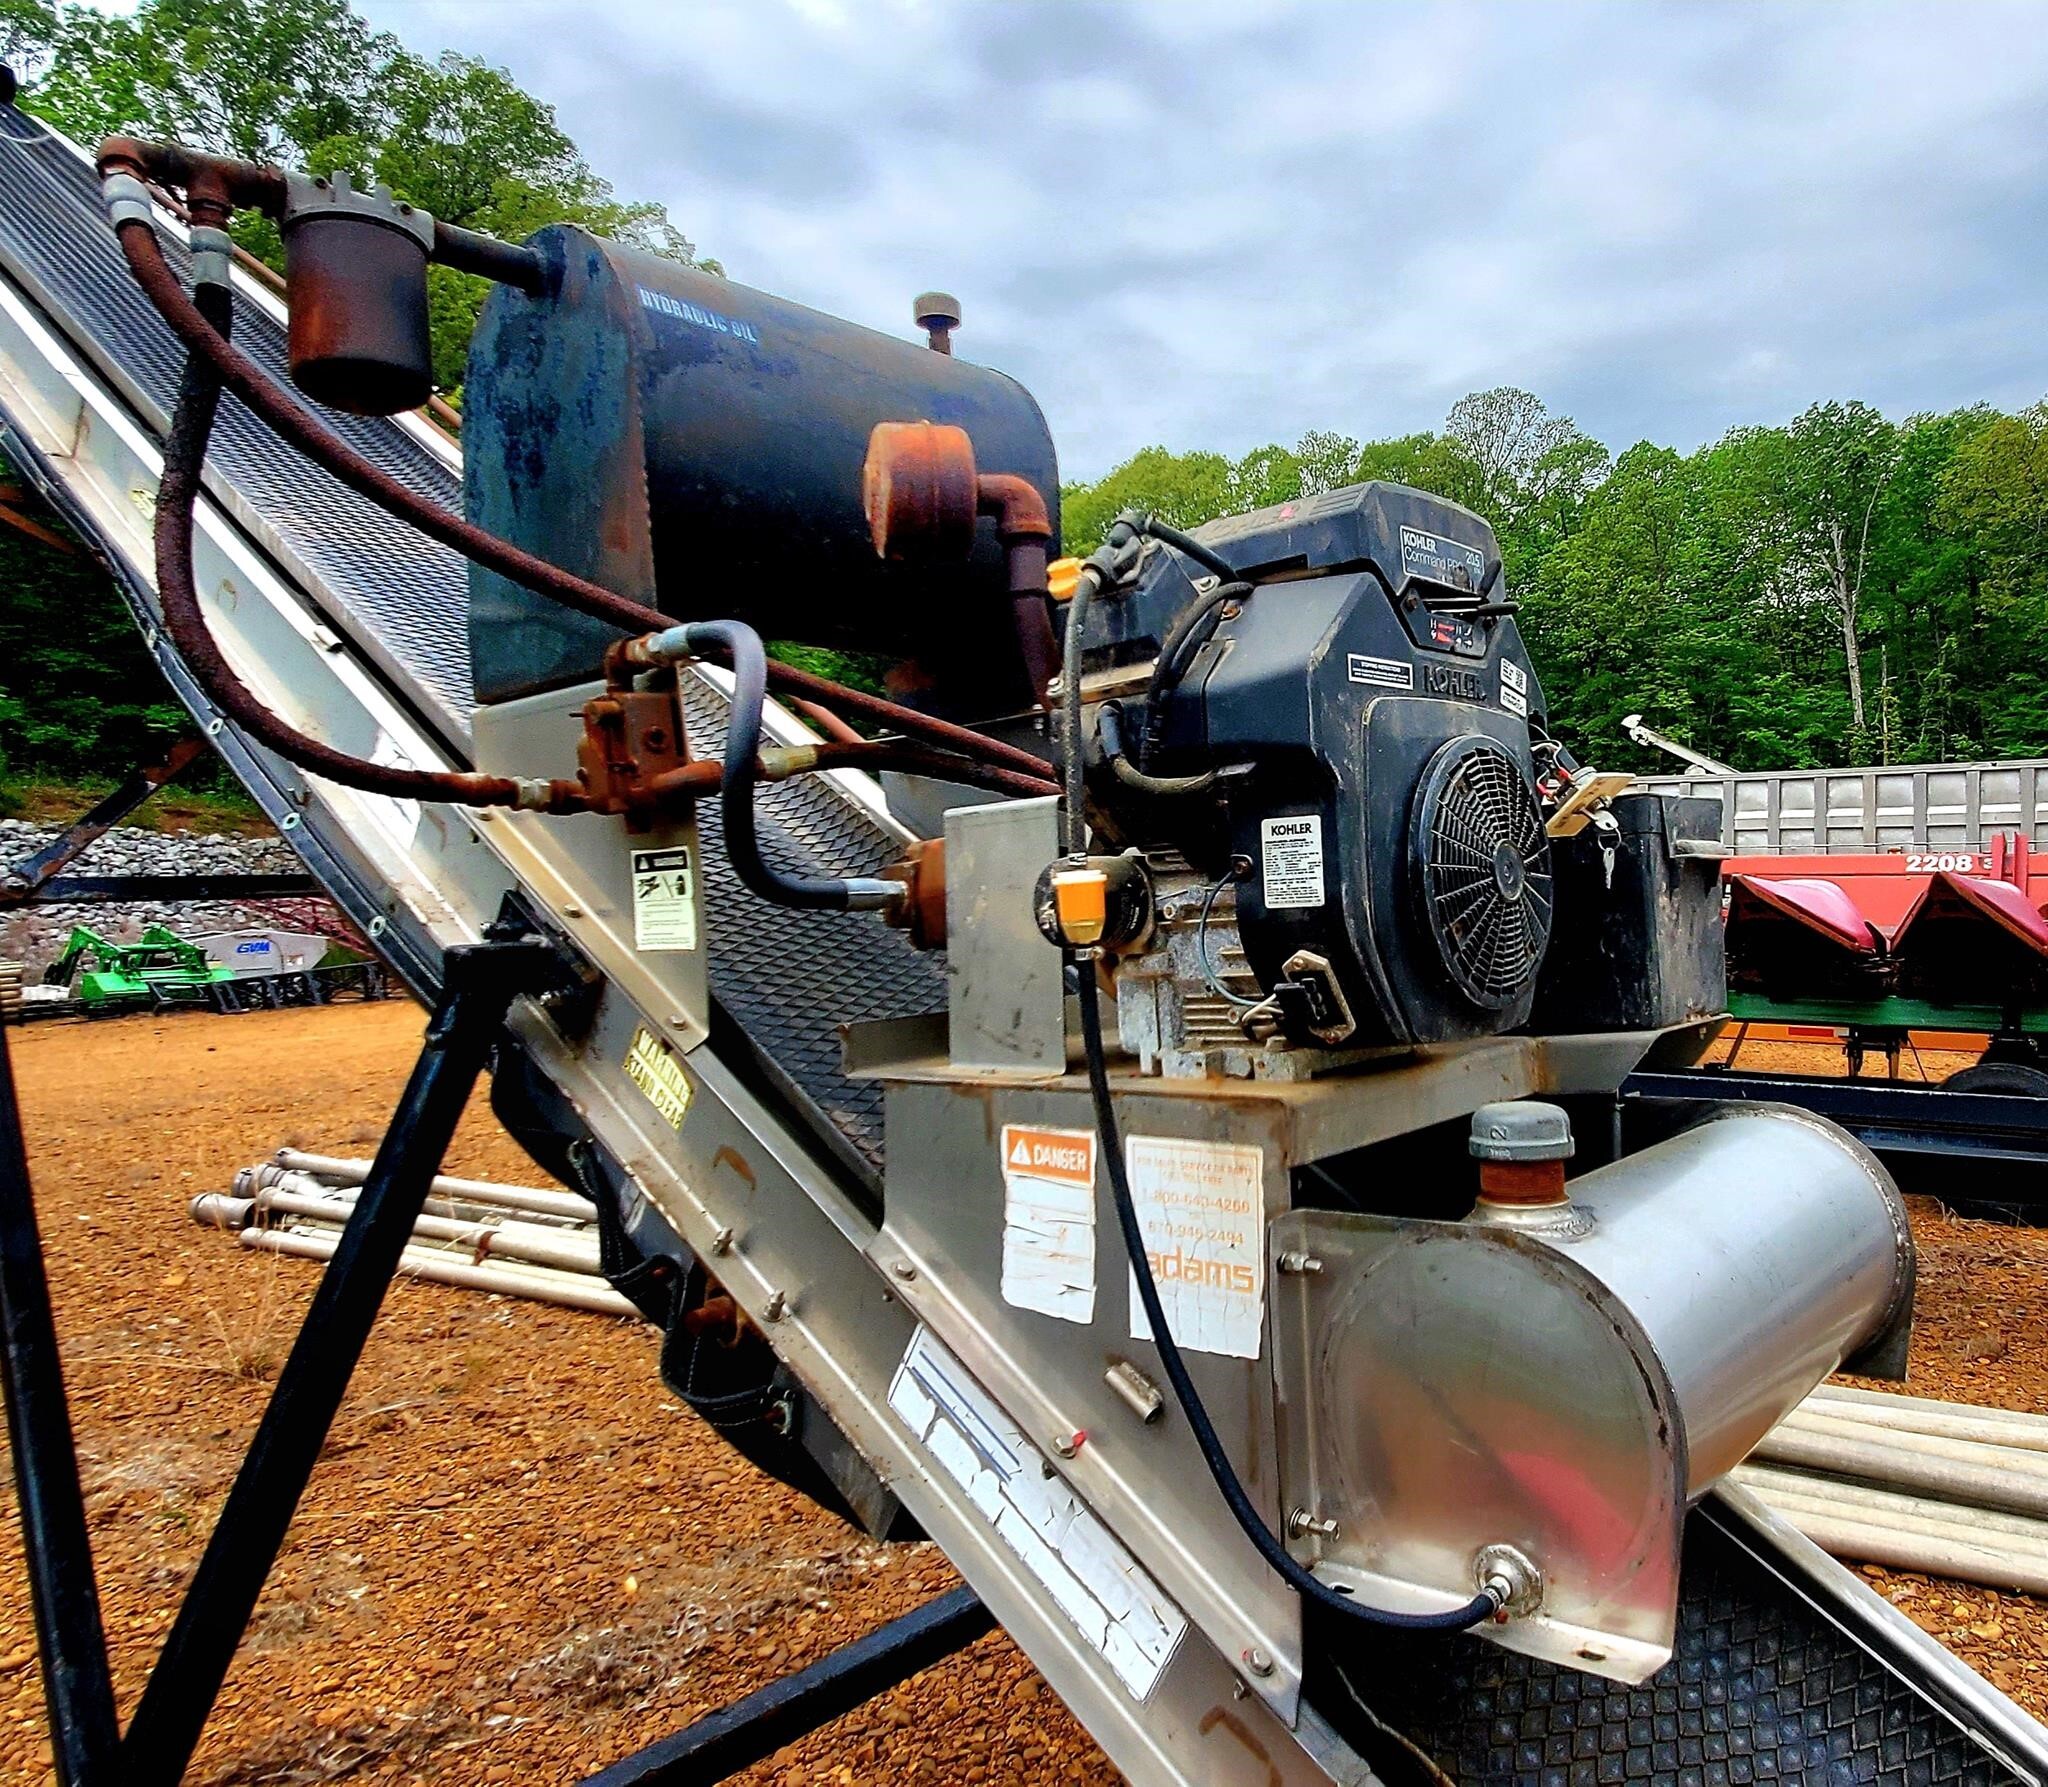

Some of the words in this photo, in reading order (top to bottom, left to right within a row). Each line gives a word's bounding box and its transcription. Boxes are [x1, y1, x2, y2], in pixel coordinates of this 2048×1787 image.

[639, 287, 729, 333] HYDRAULIC
[730, 320, 757, 343] OIL
[1403, 531, 1437, 553] KOHLER
[1404, 546, 1446, 570] Command
[1423, 665, 1487, 701] KOHLER
[1271, 823, 1312, 836] KOHLER
[1905, 855, 1973, 873] 2208
[1033, 1144, 1088, 1172] DANGER
[1146, 1245, 1255, 1295] adams
